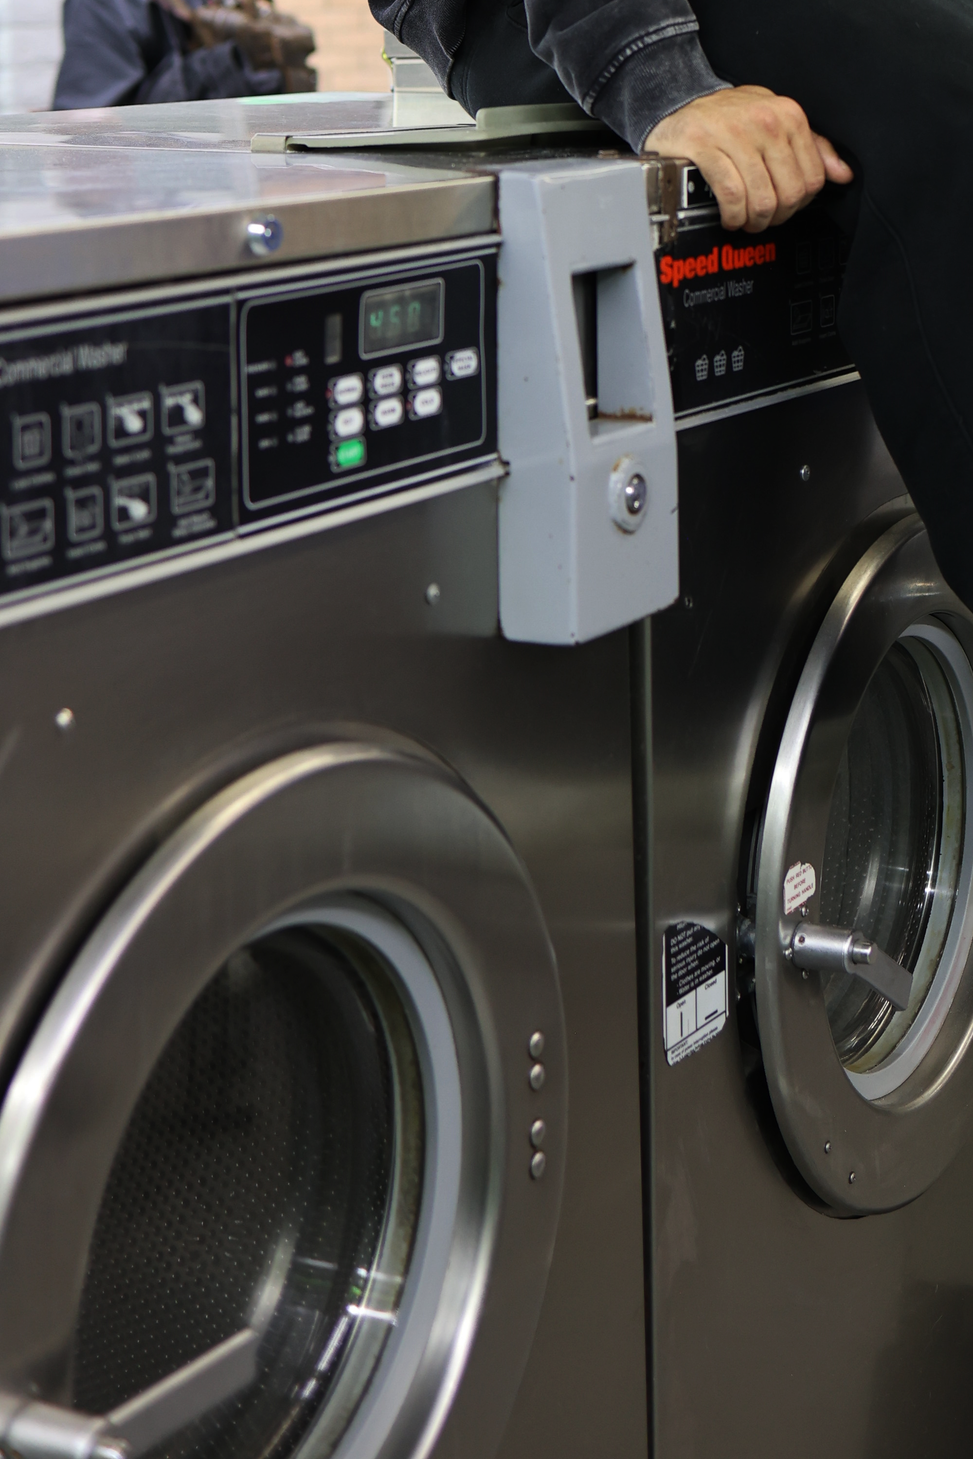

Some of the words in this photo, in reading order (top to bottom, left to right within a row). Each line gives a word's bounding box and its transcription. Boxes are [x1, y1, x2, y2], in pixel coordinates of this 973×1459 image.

[660, 246, 719, 288] Speed
[721, 243, 776, 271] Queen
[683, 281, 726, 308] Commercial
[727, 278, 754, 298] Washer
